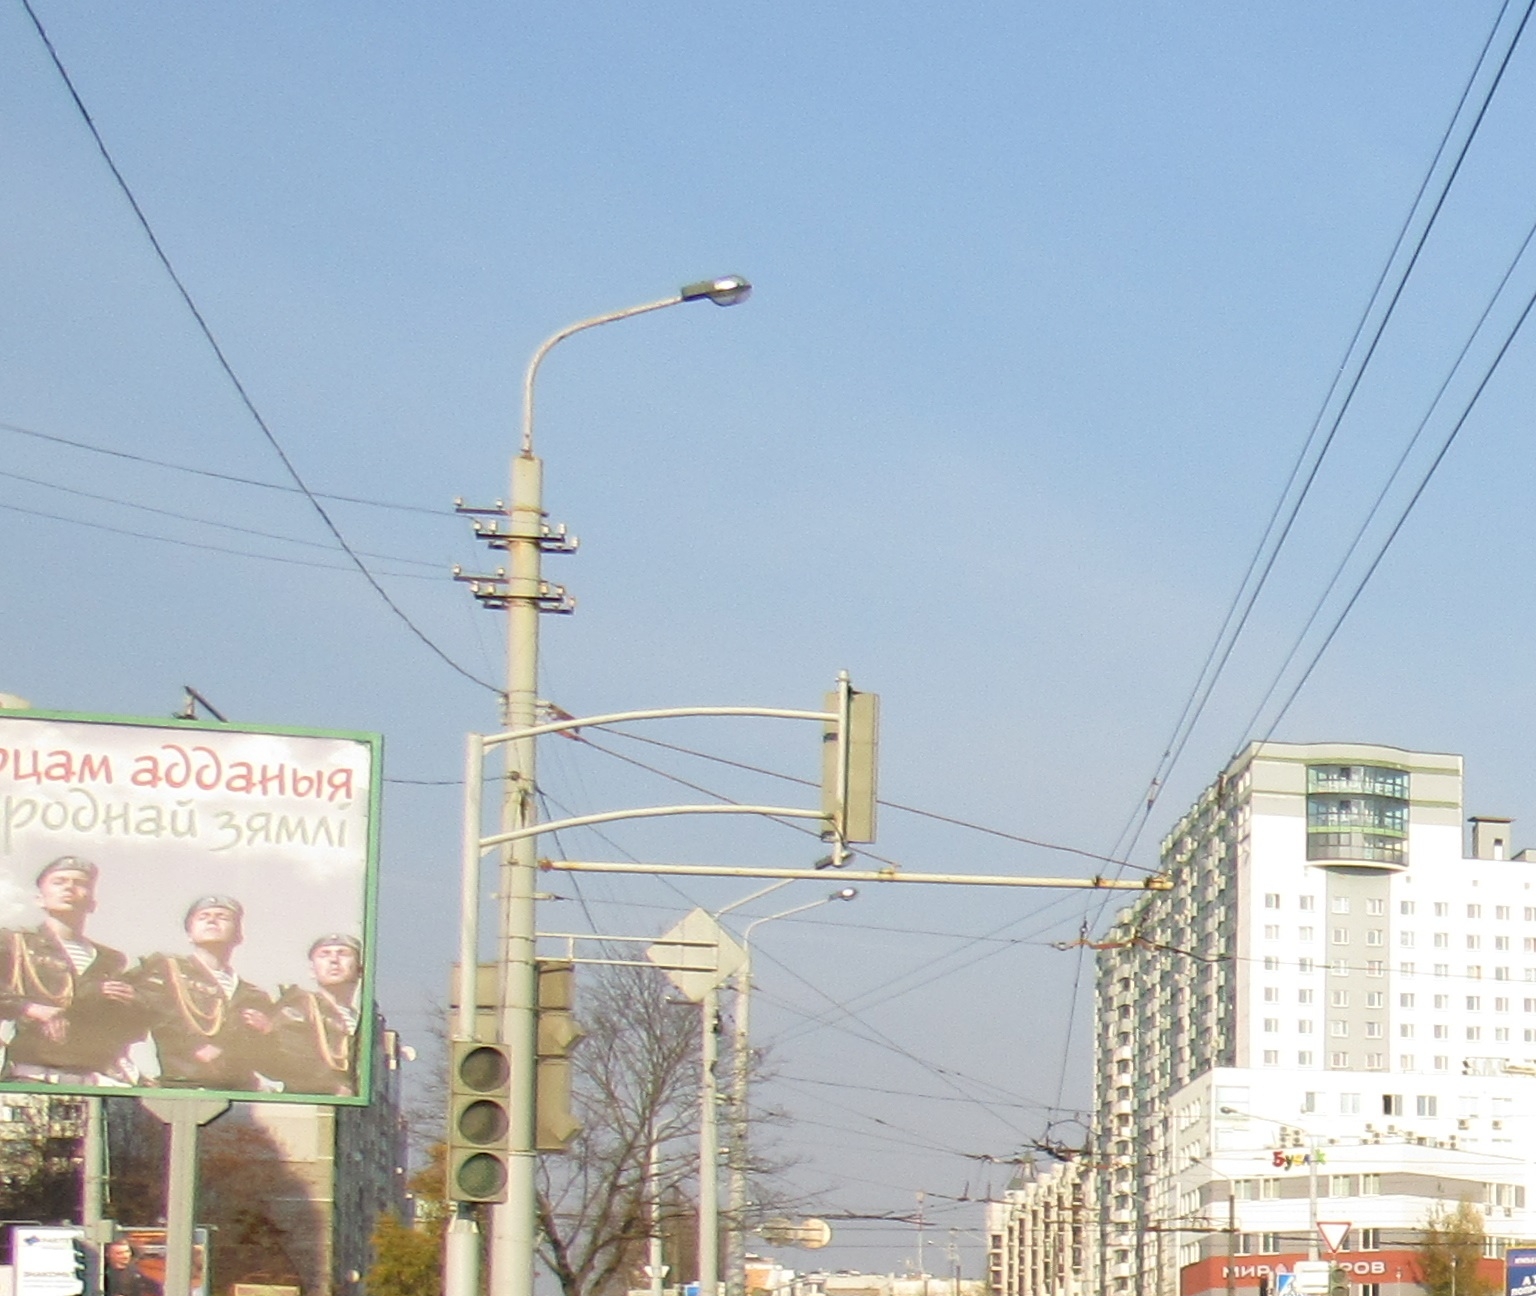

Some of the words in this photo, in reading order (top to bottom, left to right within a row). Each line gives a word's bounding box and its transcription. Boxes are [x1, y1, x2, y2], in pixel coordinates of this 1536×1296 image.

[130, 743, 354, 802] адданыя
[4, 787, 199, 852] роднай
[209, 800, 353, 852] зямлі
[1222, 1265, 1271, 1279] МИР
